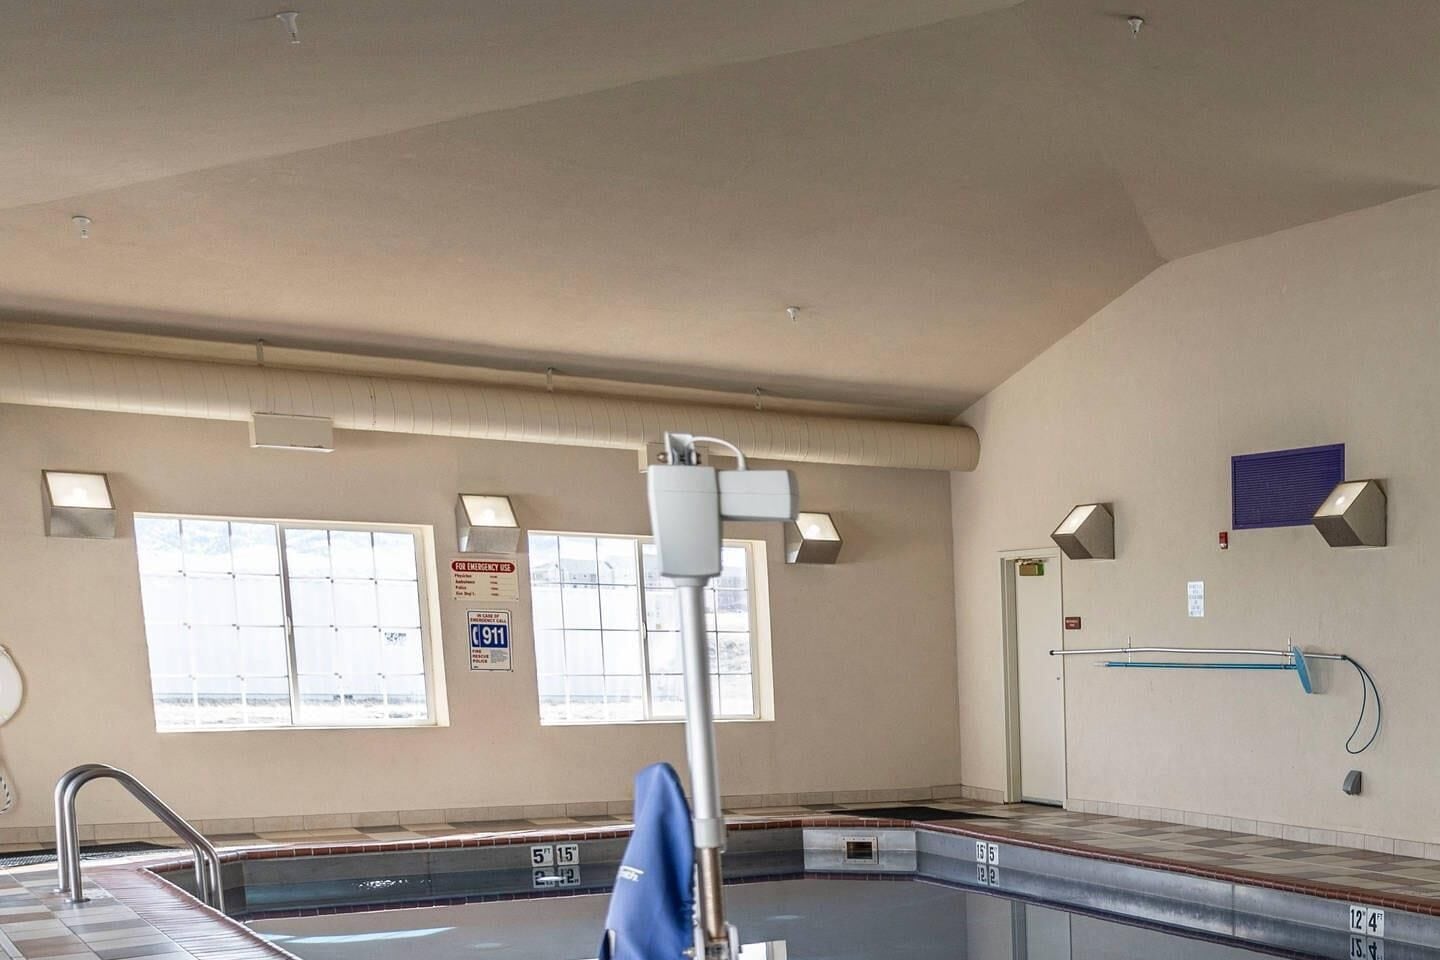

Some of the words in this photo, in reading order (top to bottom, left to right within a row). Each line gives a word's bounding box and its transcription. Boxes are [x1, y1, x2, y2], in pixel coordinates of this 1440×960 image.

[455, 562, 466, 570] FOR
[467, 562, 498, 572] EMERGENCY
[500, 564, 511, 572] USE
[482, 626, 505, 645] 911
